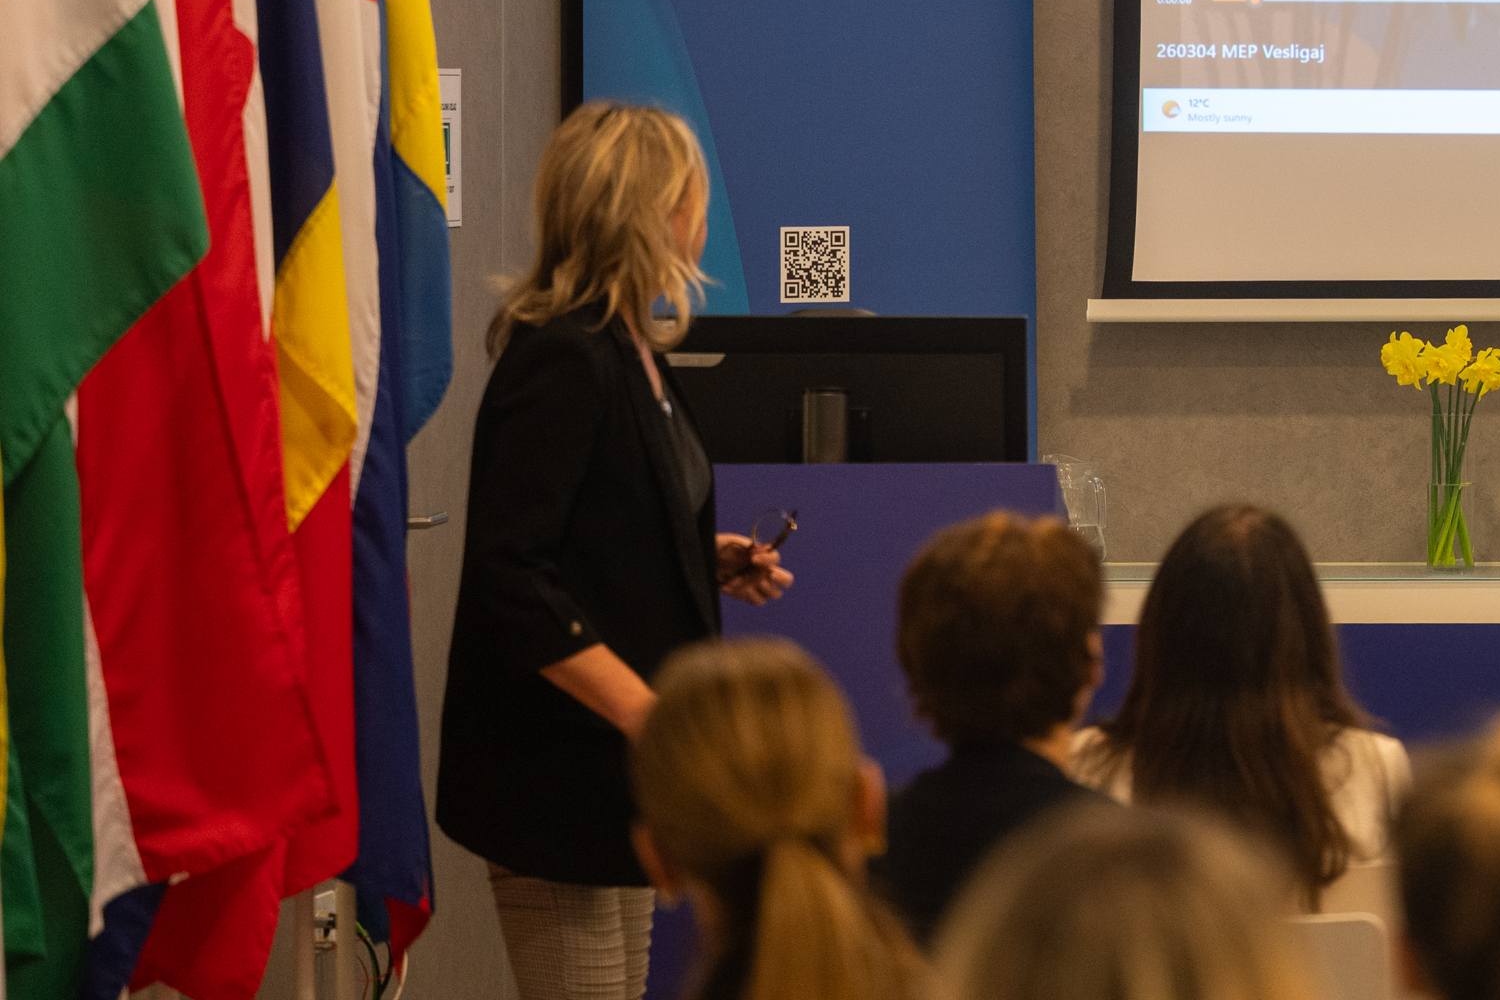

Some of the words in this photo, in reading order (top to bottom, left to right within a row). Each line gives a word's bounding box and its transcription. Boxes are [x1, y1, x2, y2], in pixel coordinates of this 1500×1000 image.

[1156, 44, 1216, 58] 260304
[1222, 44, 1258, 59] MEP
[1262, 44, 1325, 63] Vesligaj
